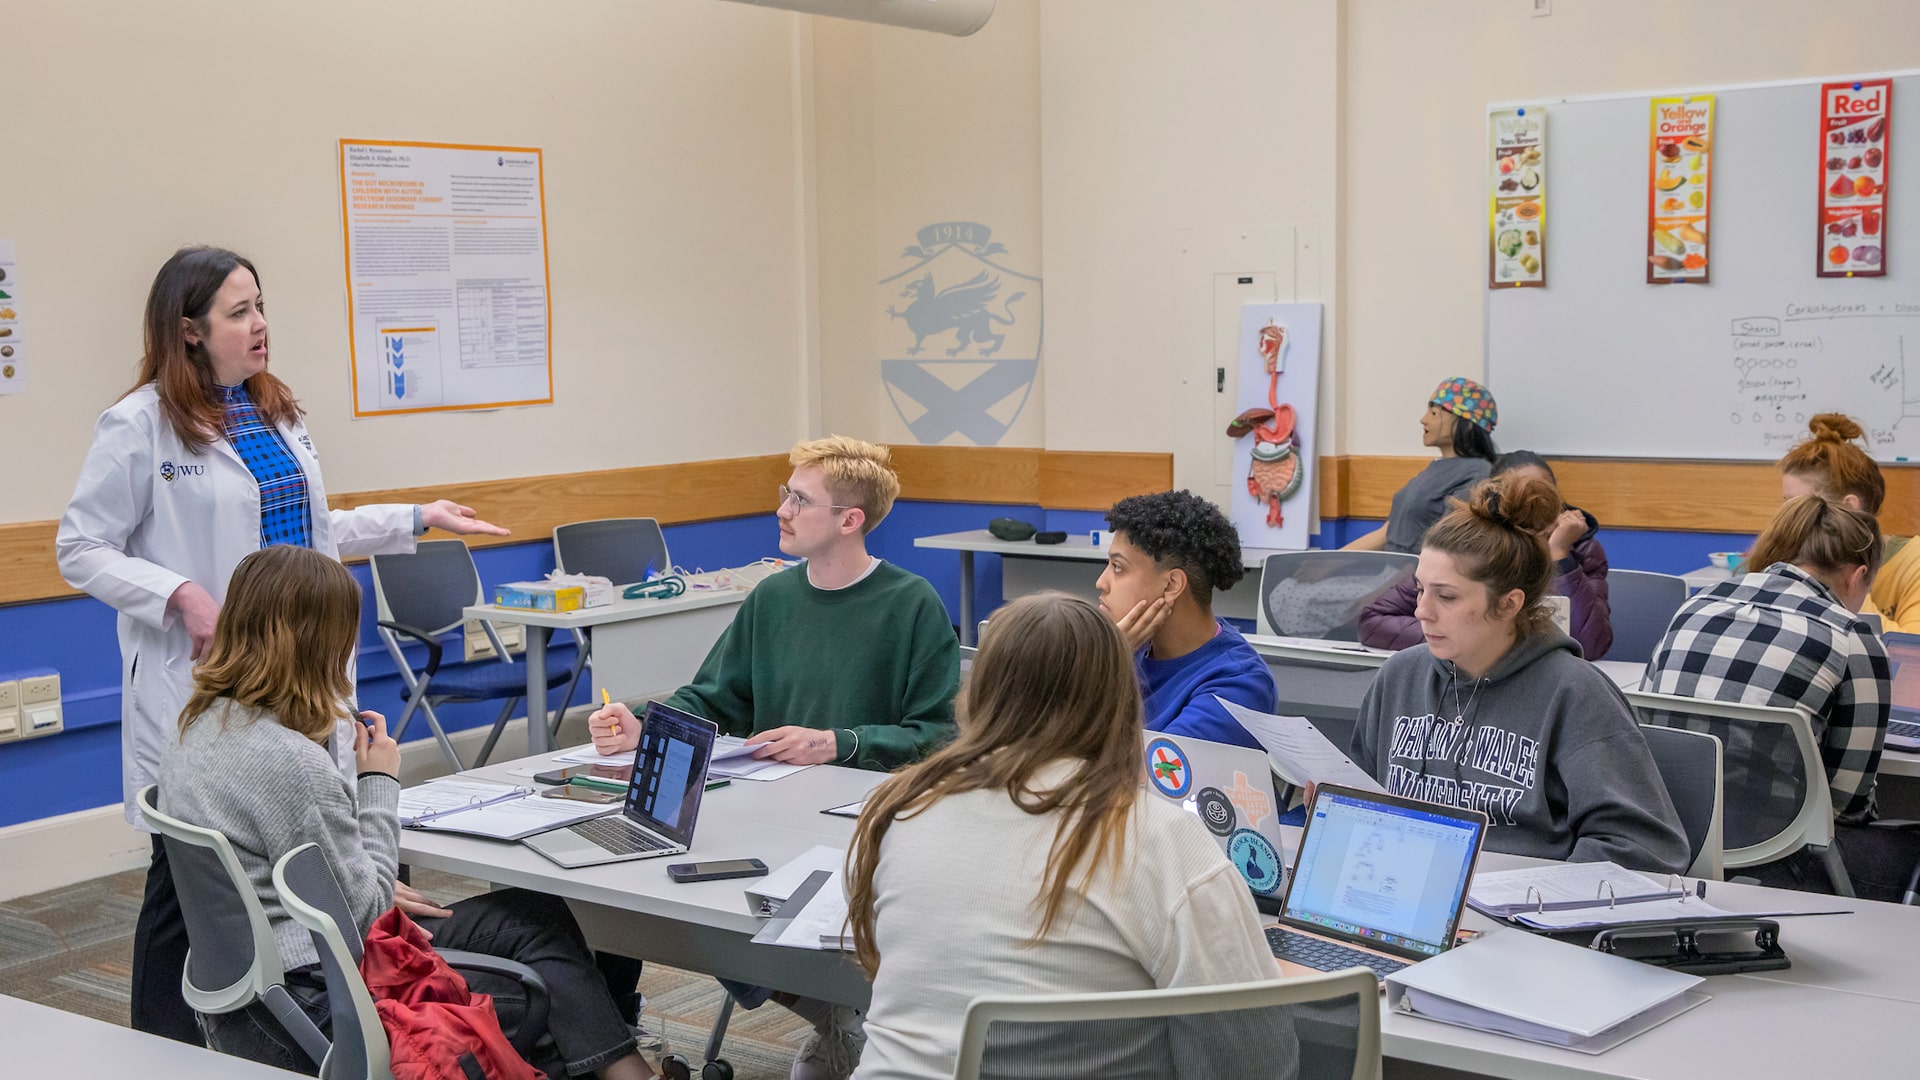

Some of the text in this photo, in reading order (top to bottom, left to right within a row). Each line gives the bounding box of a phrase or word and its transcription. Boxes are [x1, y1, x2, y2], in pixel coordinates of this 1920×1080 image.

[1834, 90, 1880, 114] Red
[1660, 105, 1707, 120] Yellow
[1660, 122, 1706, 134] Orange
[1830, 118, 1847, 126] Fruit
[1498, 148, 1513, 156] Fruit
[1828, 207, 1862, 216] Vegetables
[933, 225, 974, 242] 1914
[176, 465, 205, 481] JWU
[1472, 726, 1540, 790] WALES
[1233, 836, 1272, 860] BLOCK ISLAND
